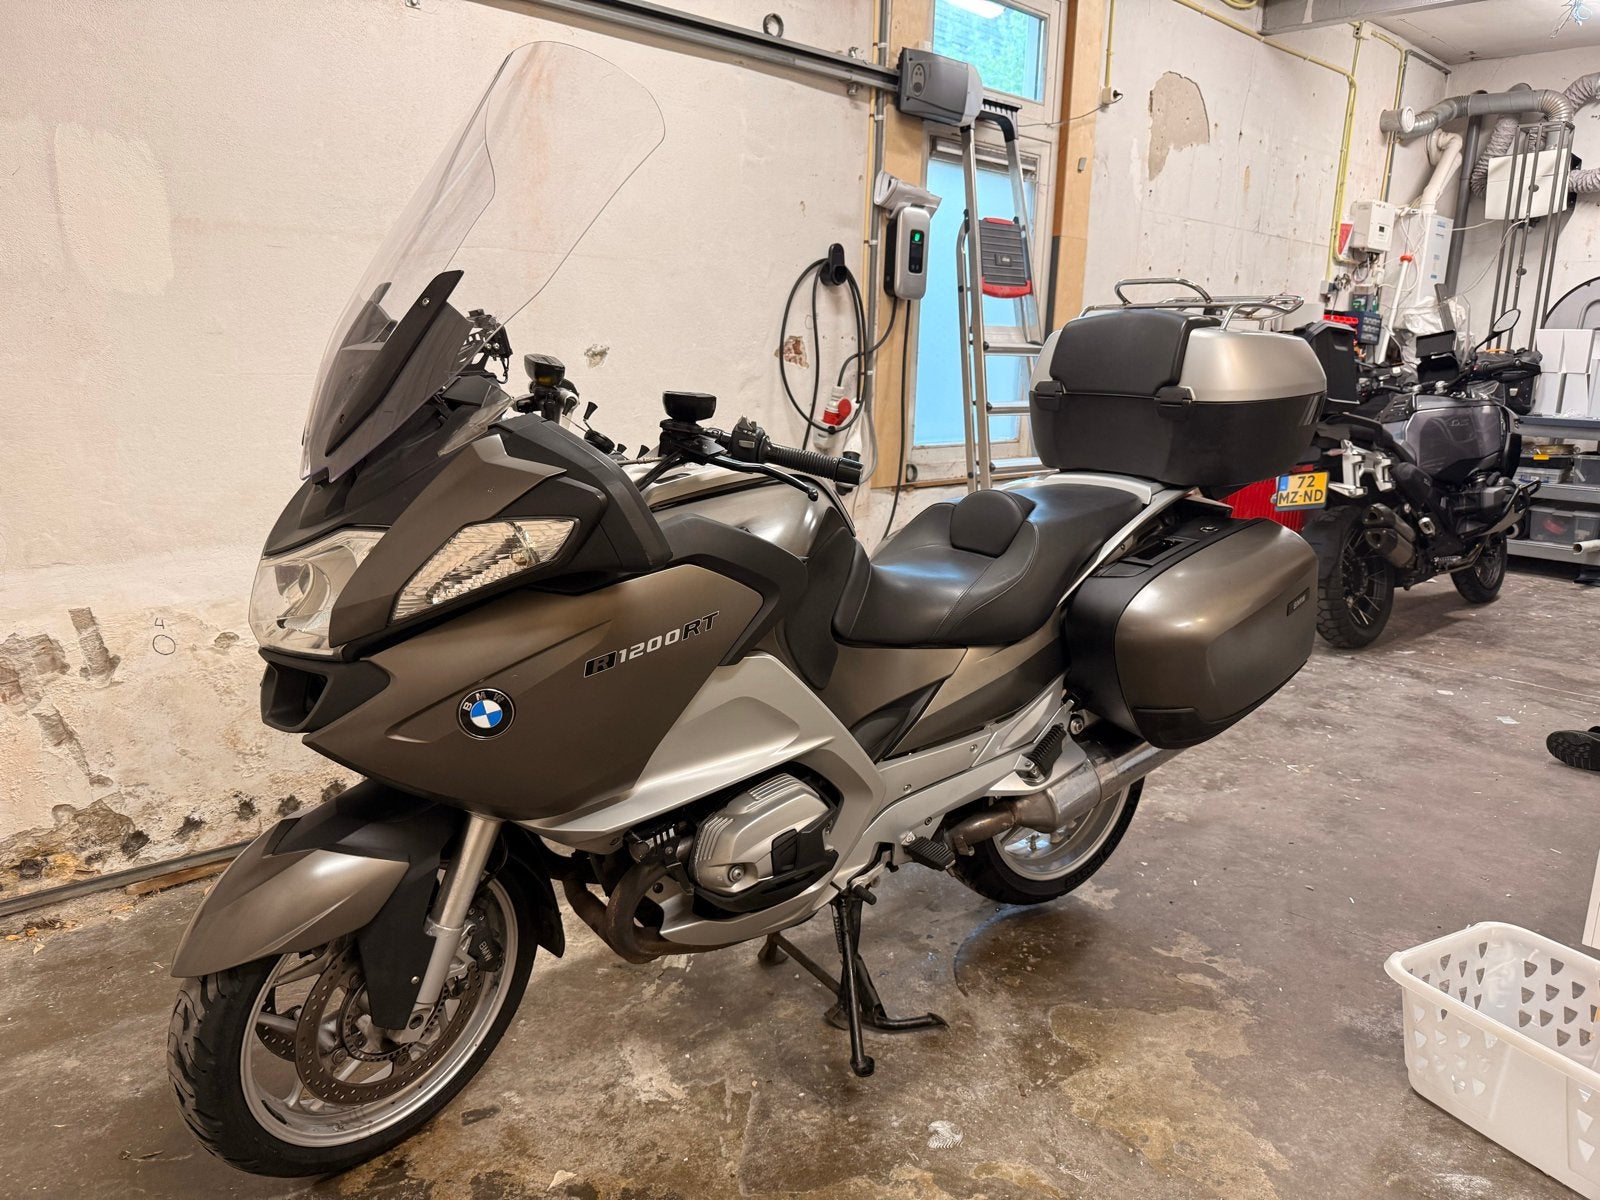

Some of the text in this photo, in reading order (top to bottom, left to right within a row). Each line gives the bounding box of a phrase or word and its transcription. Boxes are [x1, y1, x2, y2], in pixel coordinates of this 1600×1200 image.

[1297, 475, 1316, 489] 72
[1278, 489, 1323, 505] MZ-ND
[462, 691, 505, 712] BMW
[478, 940, 494, 962] BMW
